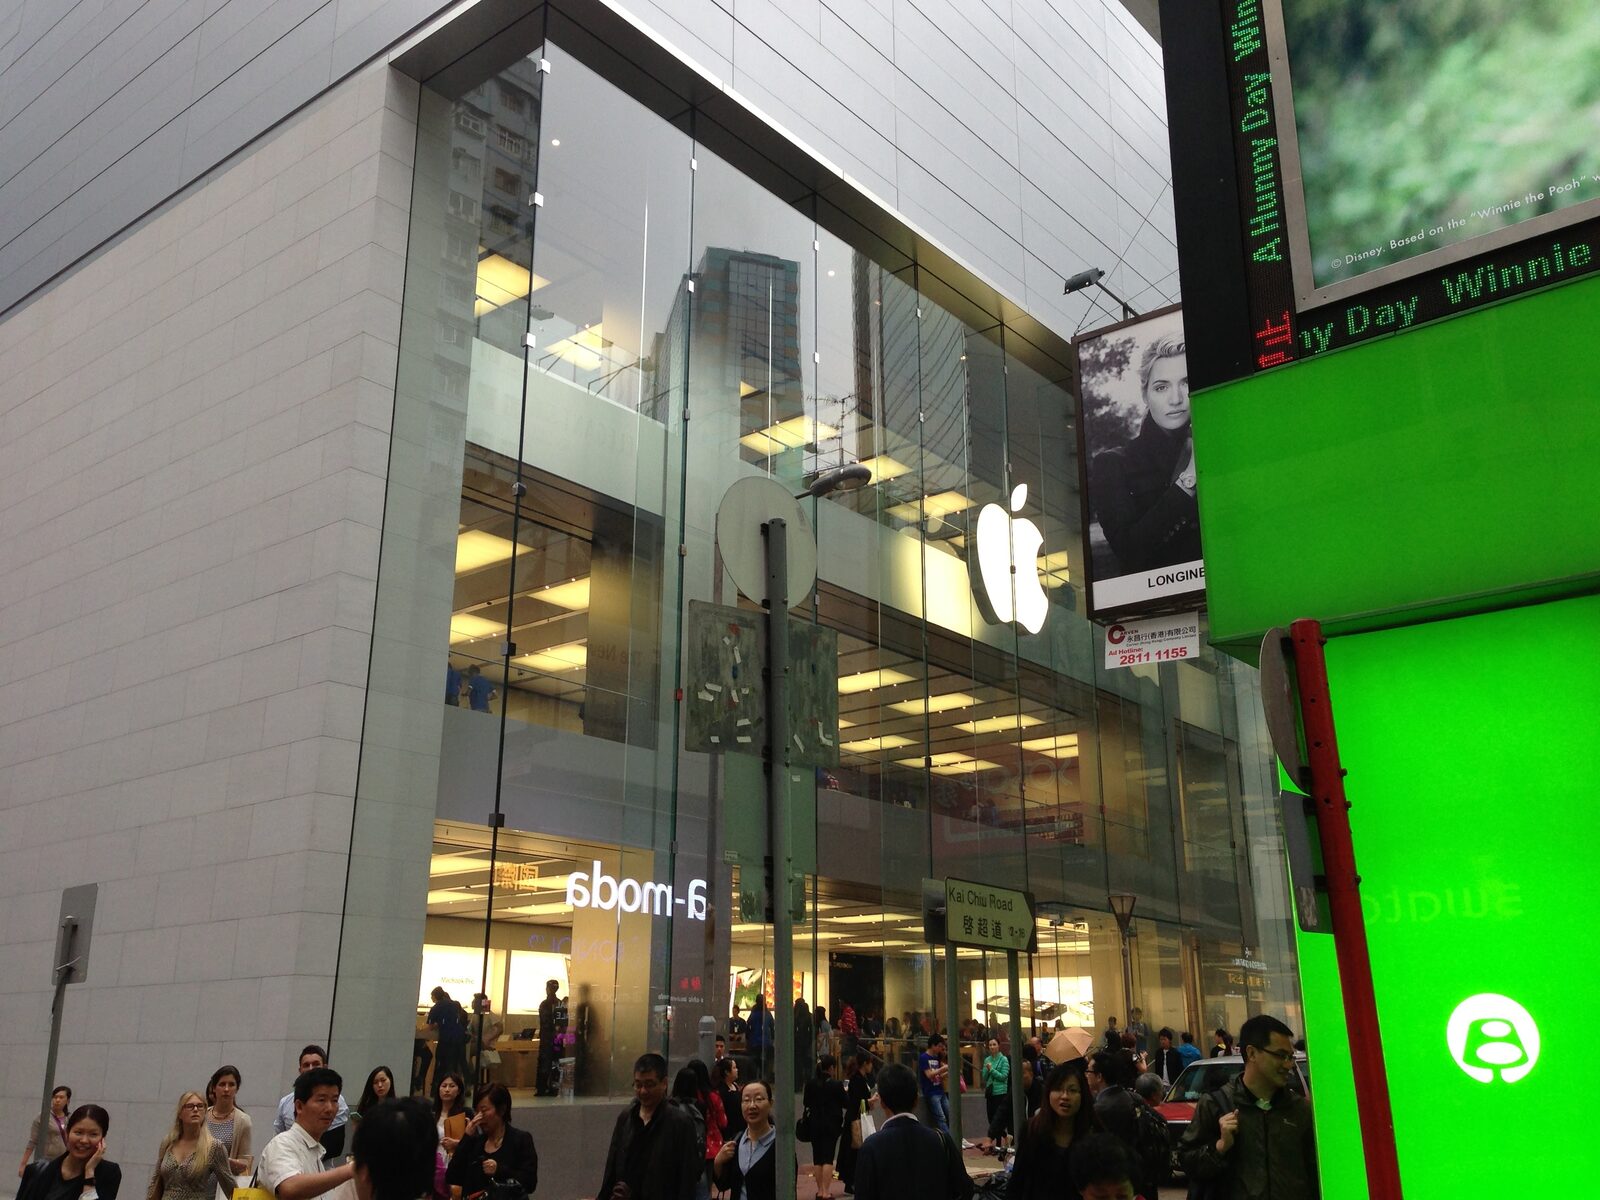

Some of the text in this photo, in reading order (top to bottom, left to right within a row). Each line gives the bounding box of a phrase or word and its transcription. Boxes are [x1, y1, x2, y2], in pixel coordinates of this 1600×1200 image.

[1242, 72, 1272, 133] Day
[1250, 138, 1280, 237] Hunny
[1253, 237, 1282, 262] A
[1345, 246, 1386, 265] Disney.
[1389, 229, 1425, 250] Based
[1428, 226, 1444, 237] on
[1447, 218, 1467, 230] the
[1524, 192, 1545, 205] the
[1346, 295, 1418, 336] Day
[1442, 243, 1592, 304] Winnie
[1118, 647, 1144, 655] Hotline:
[1120, 646, 1187, 666] 2811 1155
[948, 886, 1014, 912] Kai Chiu Road
